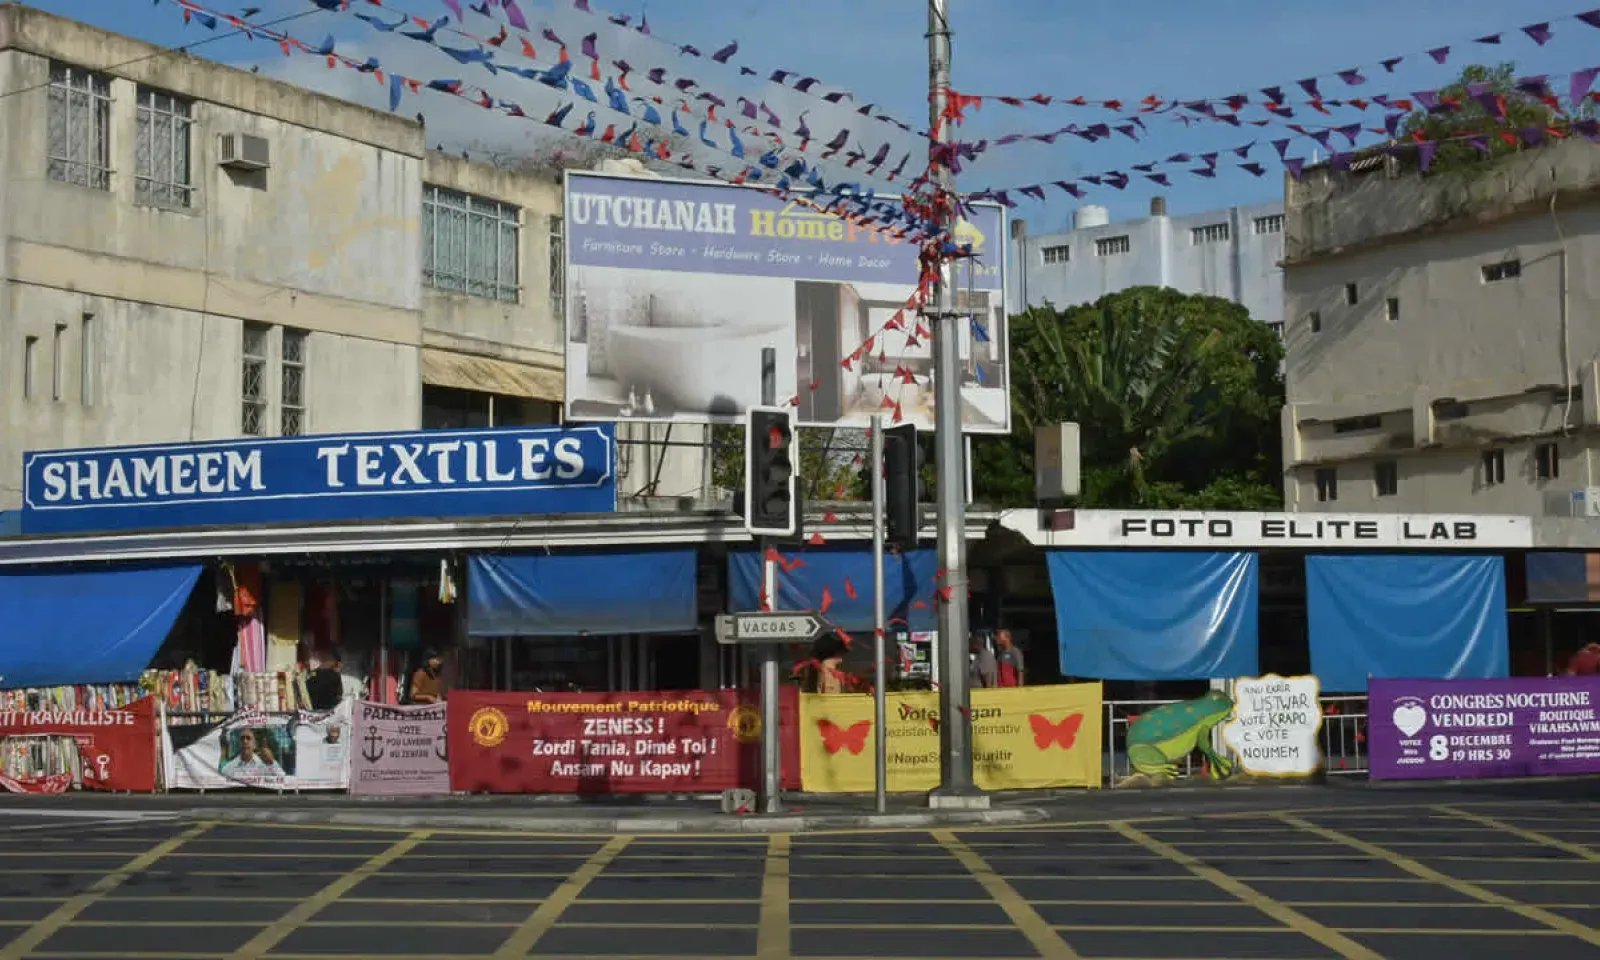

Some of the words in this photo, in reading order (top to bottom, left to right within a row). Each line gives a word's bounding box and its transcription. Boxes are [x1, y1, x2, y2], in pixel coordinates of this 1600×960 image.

[570, 192, 736, 234] UTCHANAH
[583, 237, 643, 254] Furniture
[650, 240, 685, 256] Store
[703, 245, 761, 261] Hardware
[767, 249, 800, 263] Store
[819, 251, 852, 266] Home
[42, 450, 266, 501] SHAMEEM
[317, 437, 584, 487] TEXTILES
[1121, 519, 1233, 537] FOTO
[1261, 520, 1378, 539] ELITE
[1403, 522, 1477, 540] LAB
[743, 621, 796, 633] VACOAS
[527, 701, 622, 713] Mouvement
[628, 700, 720, 715] Patriotique
[1253, 693, 1309, 712] LISTWAR
[1506, 692, 1589, 708] NOCTURNE
[0, 711, 15, 726] TI
[23, 710, 134, 726] TRAVAILLISTE
[363, 707, 405, 721] PARTI
[898, 704, 938, 721] Vote
[970, 708, 1001, 722] gan
[1269, 711, 1306, 728] KRAPO
[1432, 712, 1513, 727] VENDREDI
[1540, 709, 1594, 721] BOUTIQUE
[398, 725, 421, 735] VOTE
[584, 718, 654, 735] ZENESS
[1258, 729, 1288, 740] VOTE
[533, 740, 576, 755] Zordi
[581, 740, 630, 757] Tania,
[1243, 746, 1299, 758] NOUMEM
[1429, 735, 1449, 760] 8
[1450, 734, 1512, 746] DECEMBRE
[1453, 750, 1465, 760] 19
[1468, 749, 1493, 760] HRS
[1496, 748, 1511, 760] 30
[550, 760, 605, 776] Ansam
[611, 760, 634, 776] Nu
[640, 760, 691, 779] Kapav
